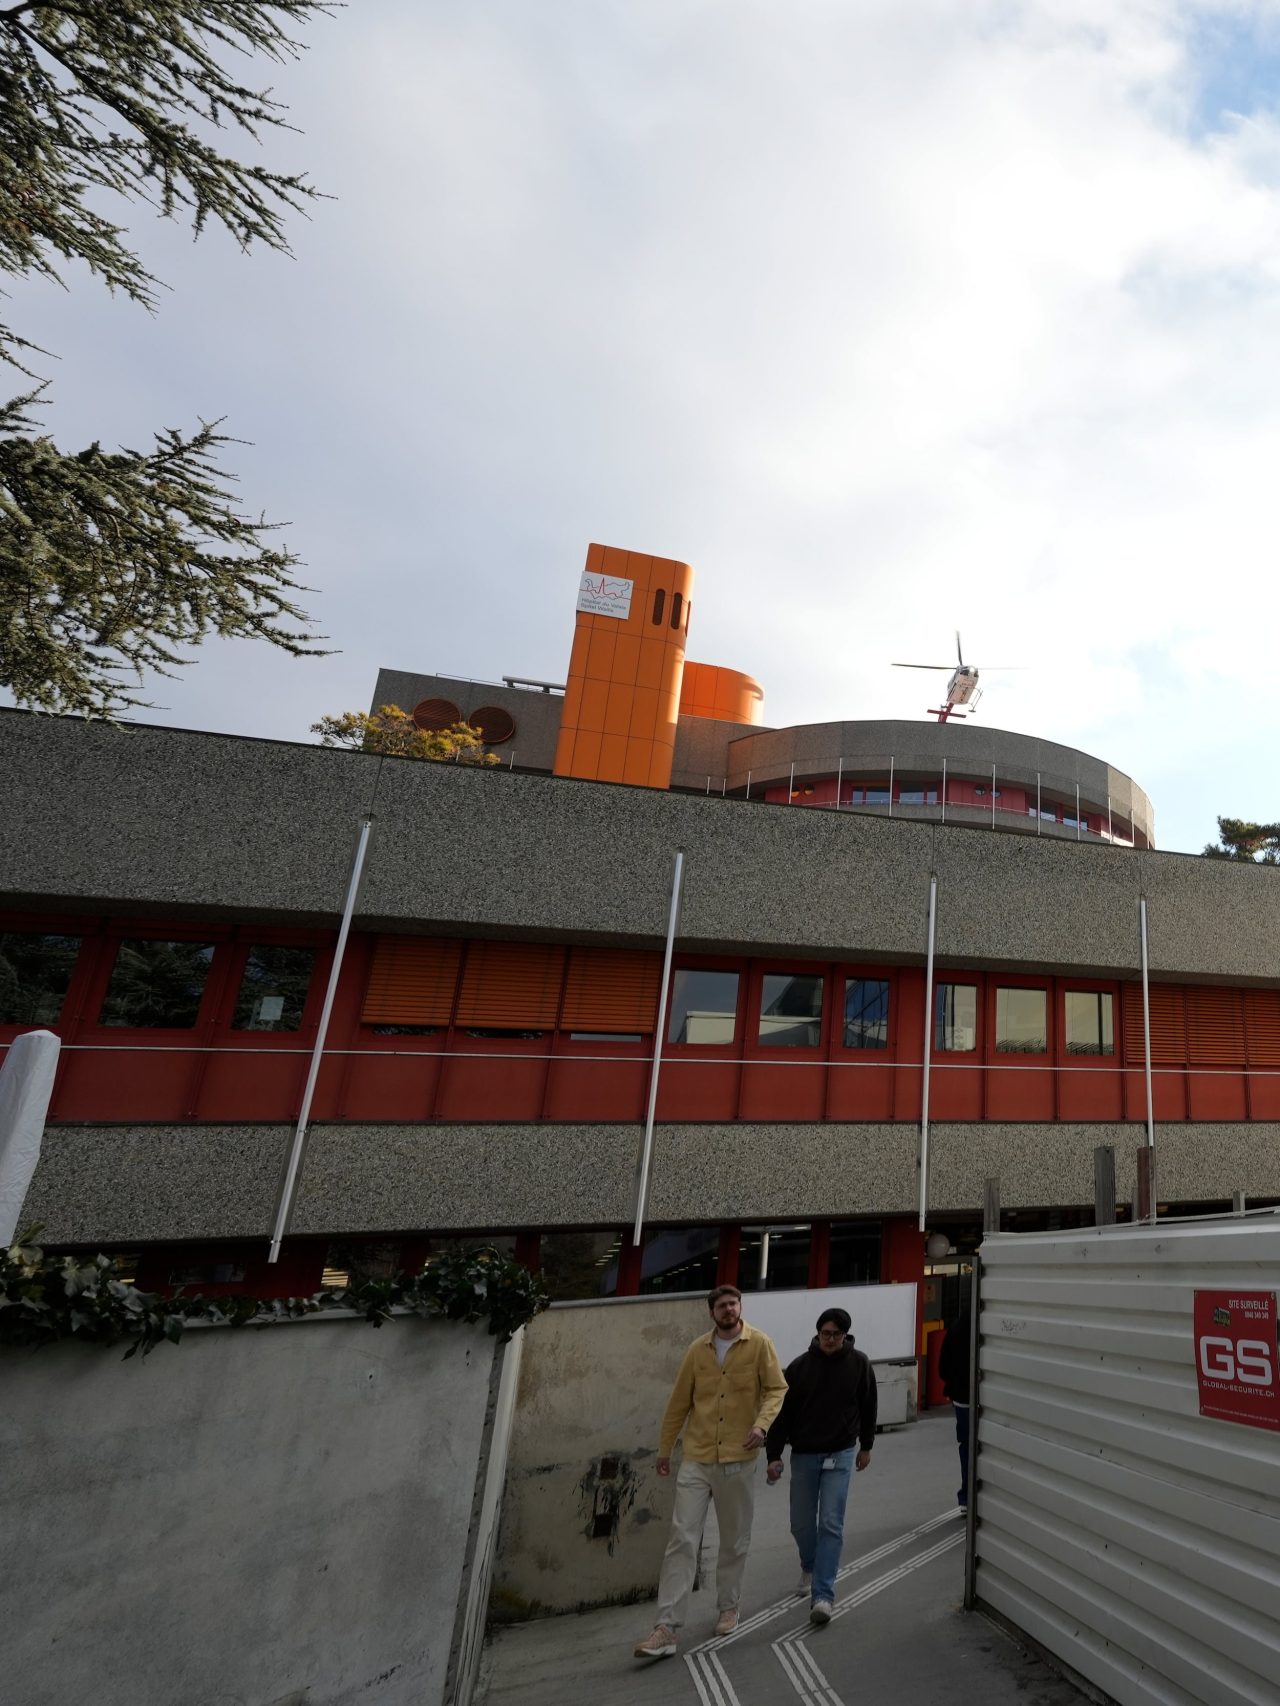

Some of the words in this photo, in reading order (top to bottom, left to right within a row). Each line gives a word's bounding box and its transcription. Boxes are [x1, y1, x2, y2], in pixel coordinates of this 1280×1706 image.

[1228, 1299, 1240, 1309] SITE
[1240, 1298, 1269, 1311] SURVEILLÉ
[1200, 1335, 1273, 1386] GS
